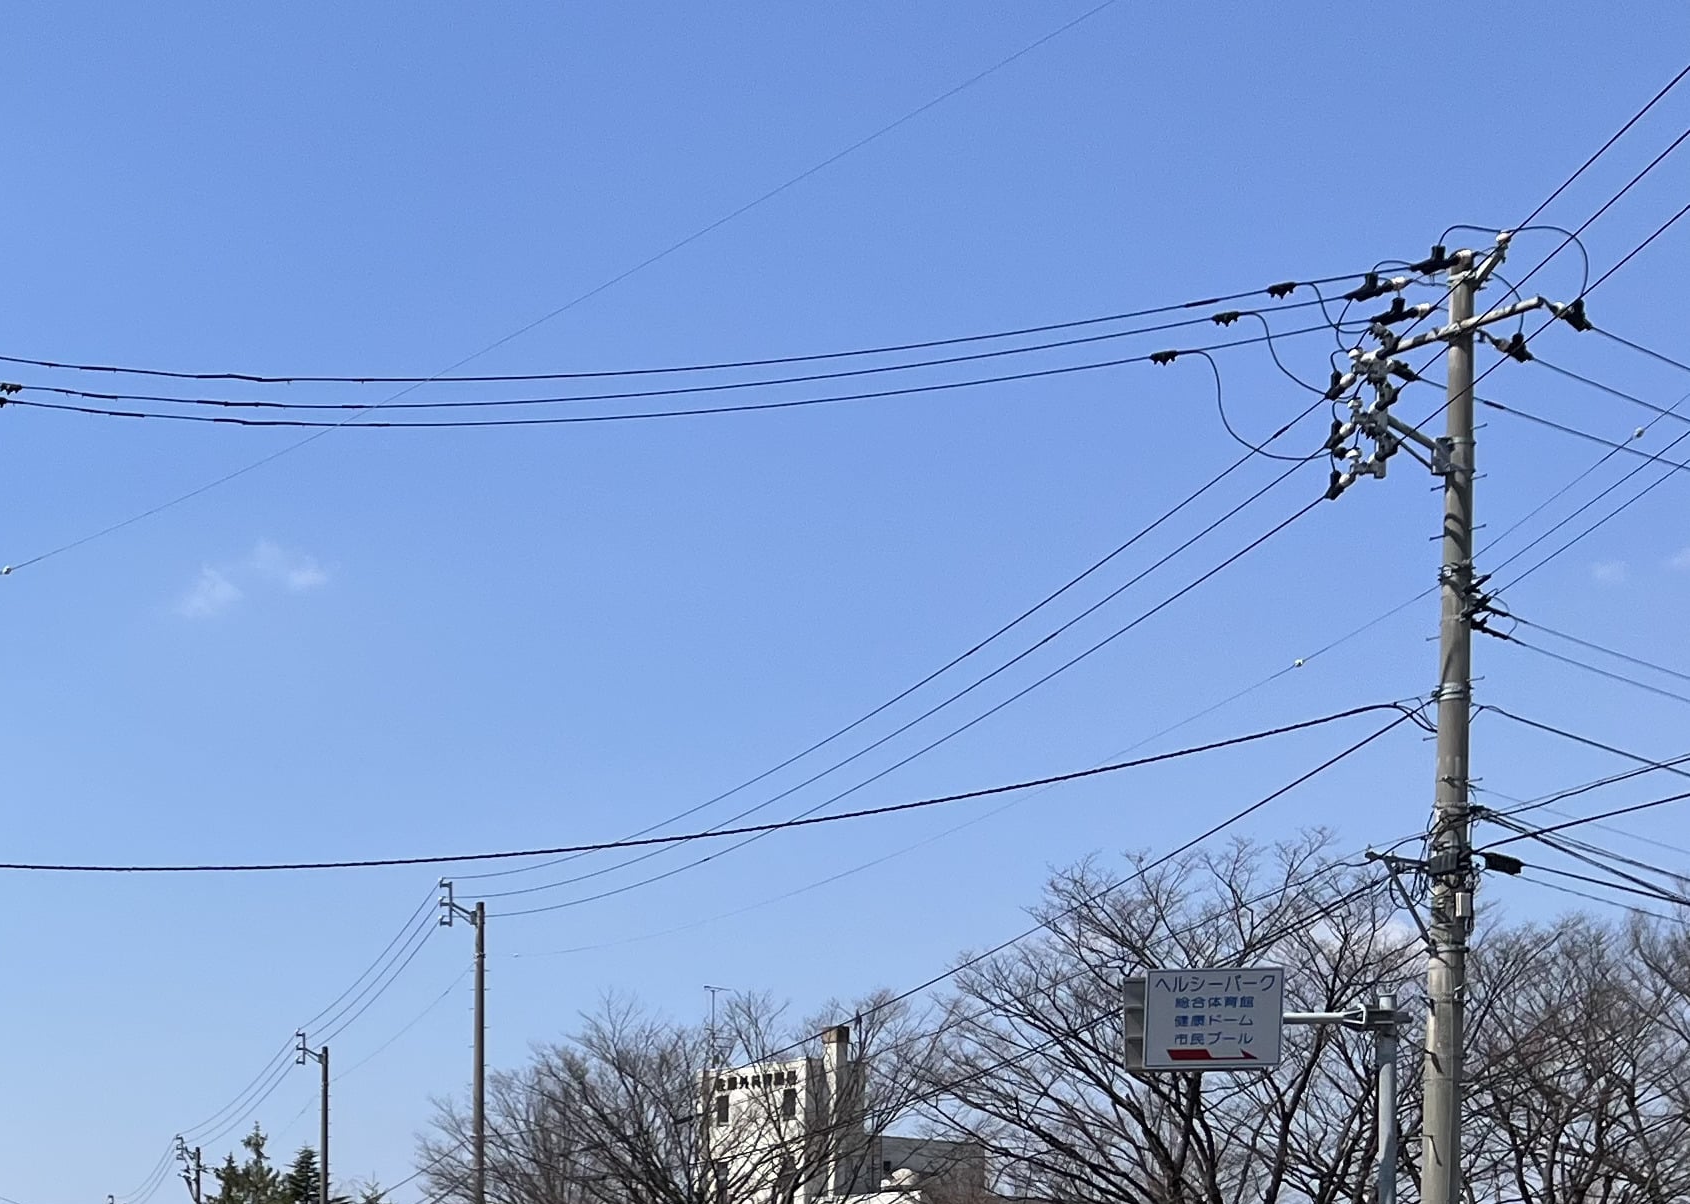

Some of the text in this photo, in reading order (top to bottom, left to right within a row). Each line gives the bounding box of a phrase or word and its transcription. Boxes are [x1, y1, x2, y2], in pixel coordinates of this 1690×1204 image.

[1174, 996, 1255, 1009] 総合体育館
[1174, 1014, 1254, 1027] 健康ドーム
[1174, 1031, 1254, 1045] 市民プール
